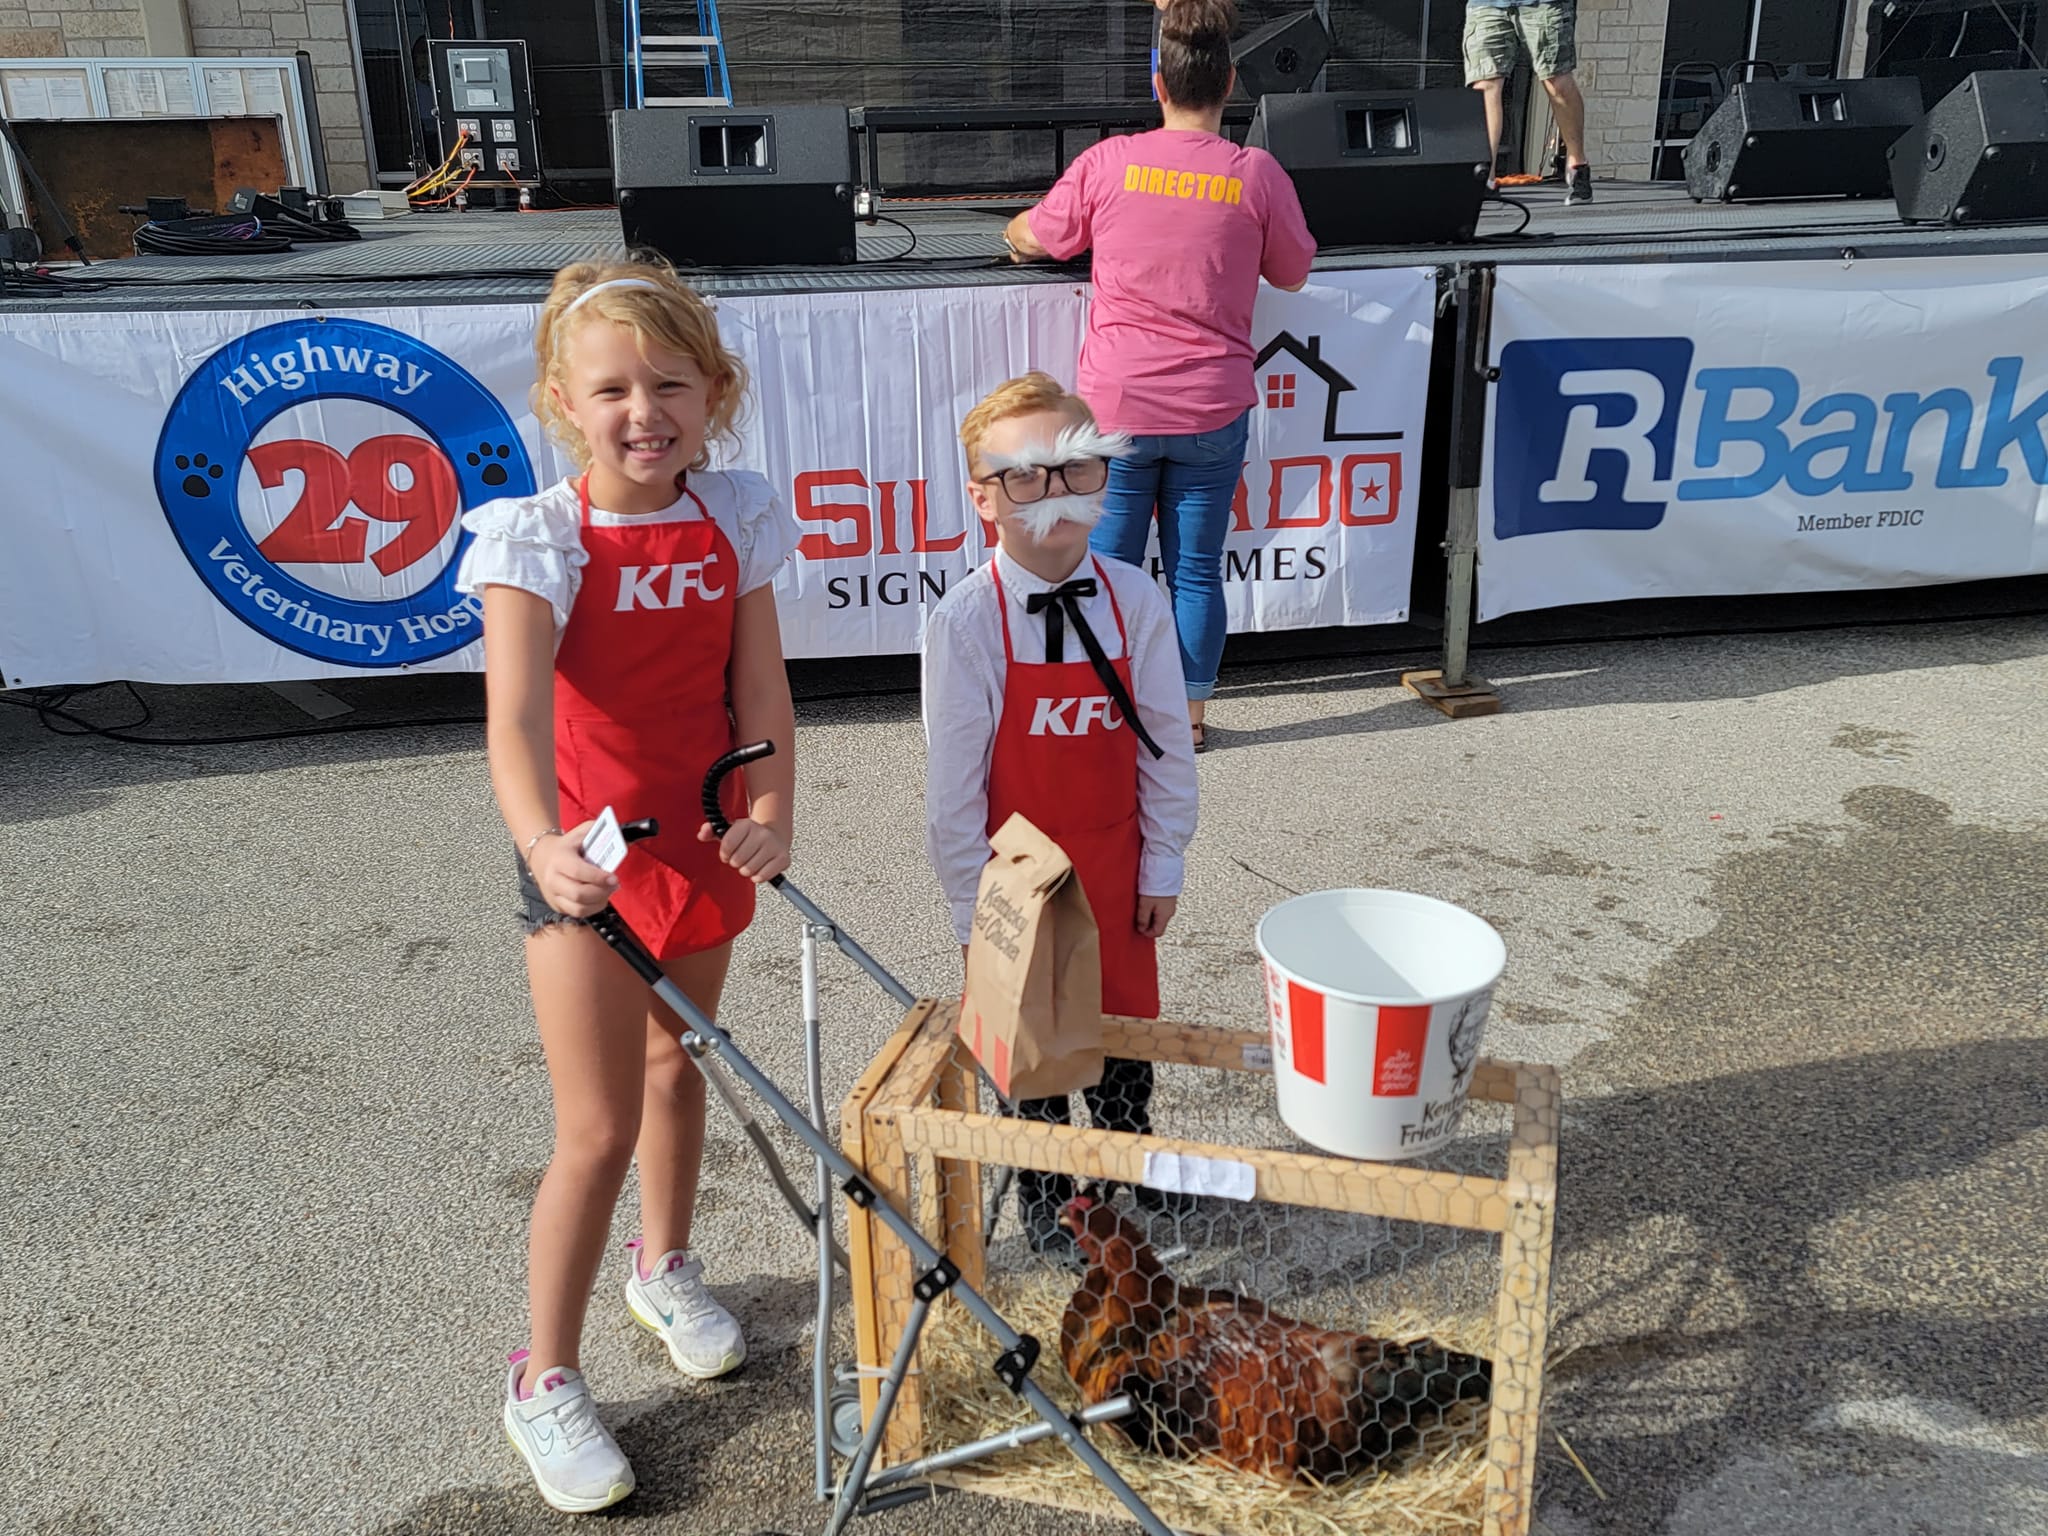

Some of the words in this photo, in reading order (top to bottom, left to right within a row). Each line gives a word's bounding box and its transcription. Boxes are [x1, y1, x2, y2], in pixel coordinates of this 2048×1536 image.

[1124, 164, 1243, 205] DIRECTOR
[220, 337, 432, 407] Highway
[246, 434, 460, 577] 29
[1797, 513, 1872, 531] Member
[1876, 509, 1924, 527] FDIC
[207, 537, 392, 656] Veterinary
[612, 553, 726, 612] KFC
[1028, 695, 1124, 736] KFC
[1401, 1118, 1444, 1146] Fried
